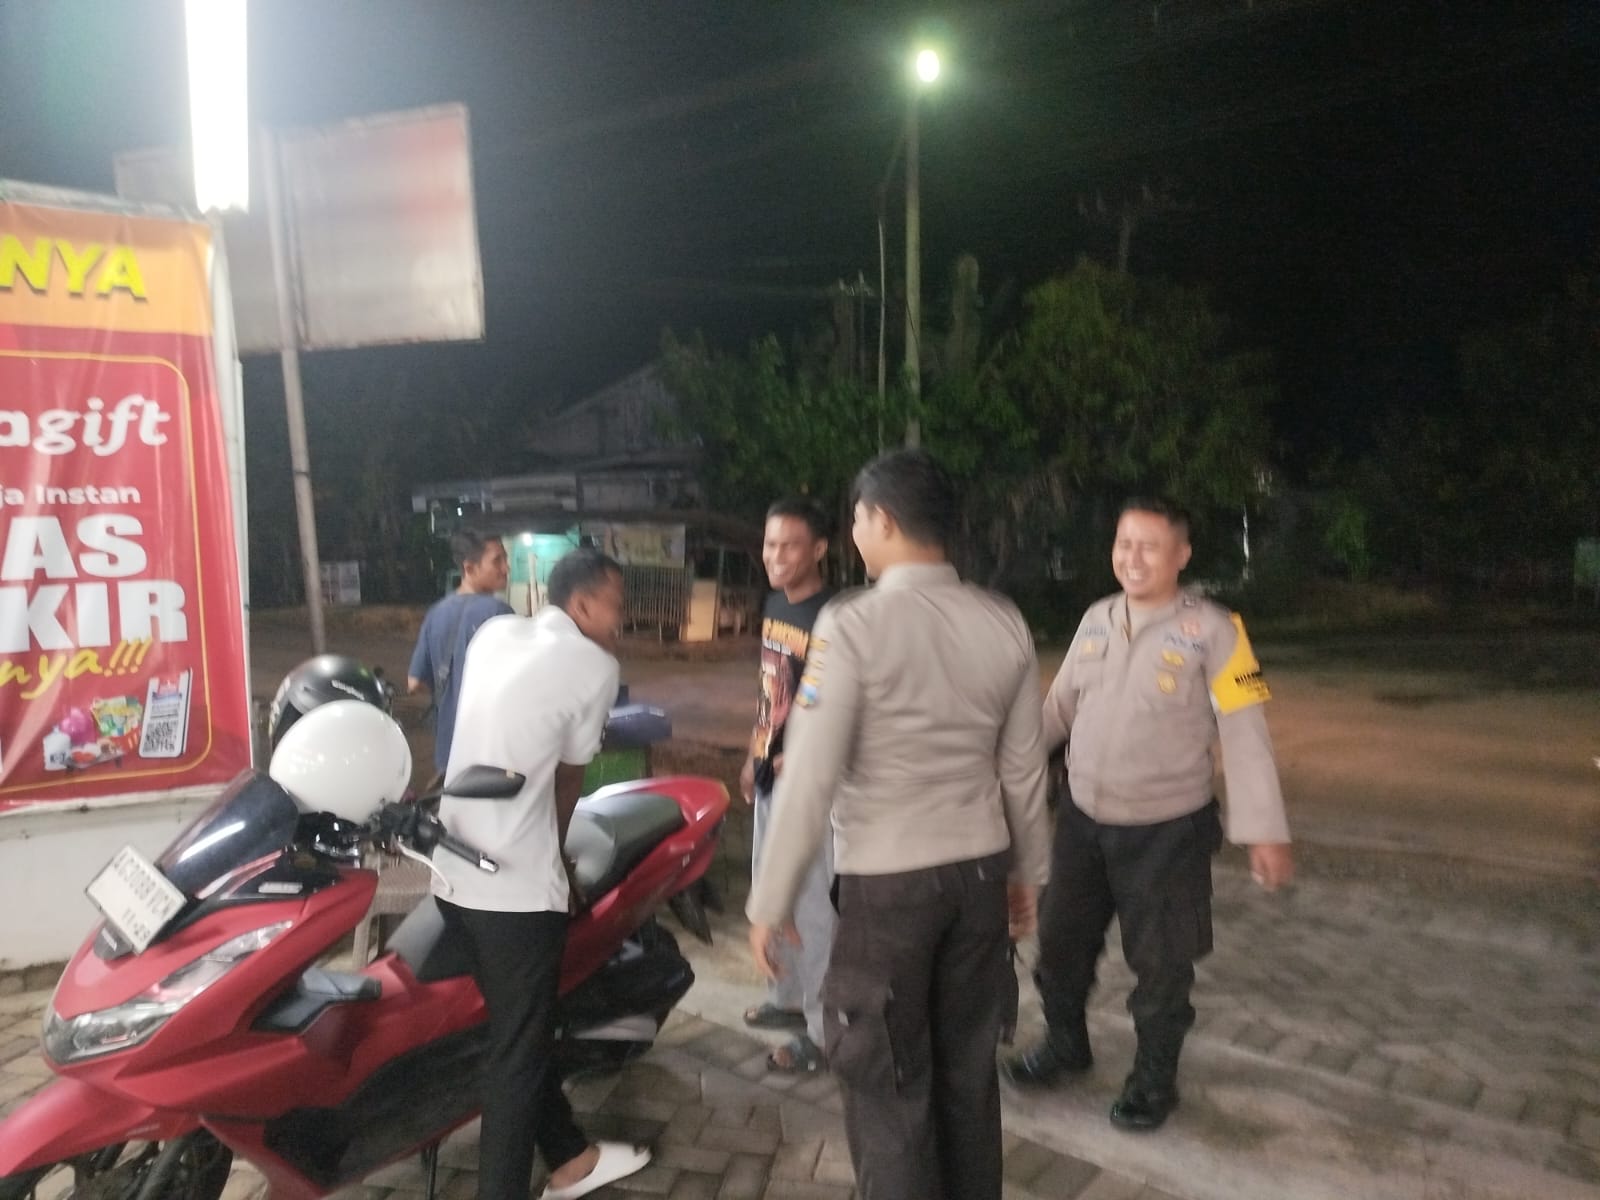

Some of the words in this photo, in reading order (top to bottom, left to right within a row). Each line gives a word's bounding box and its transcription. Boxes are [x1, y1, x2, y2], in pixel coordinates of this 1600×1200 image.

[0, 233, 148, 301] NYA
[0, 394, 171, 456] agift
[35, 484, 141, 505] Instan
[0, 513, 148, 581] AS
[0, 580, 188, 653] KIR
